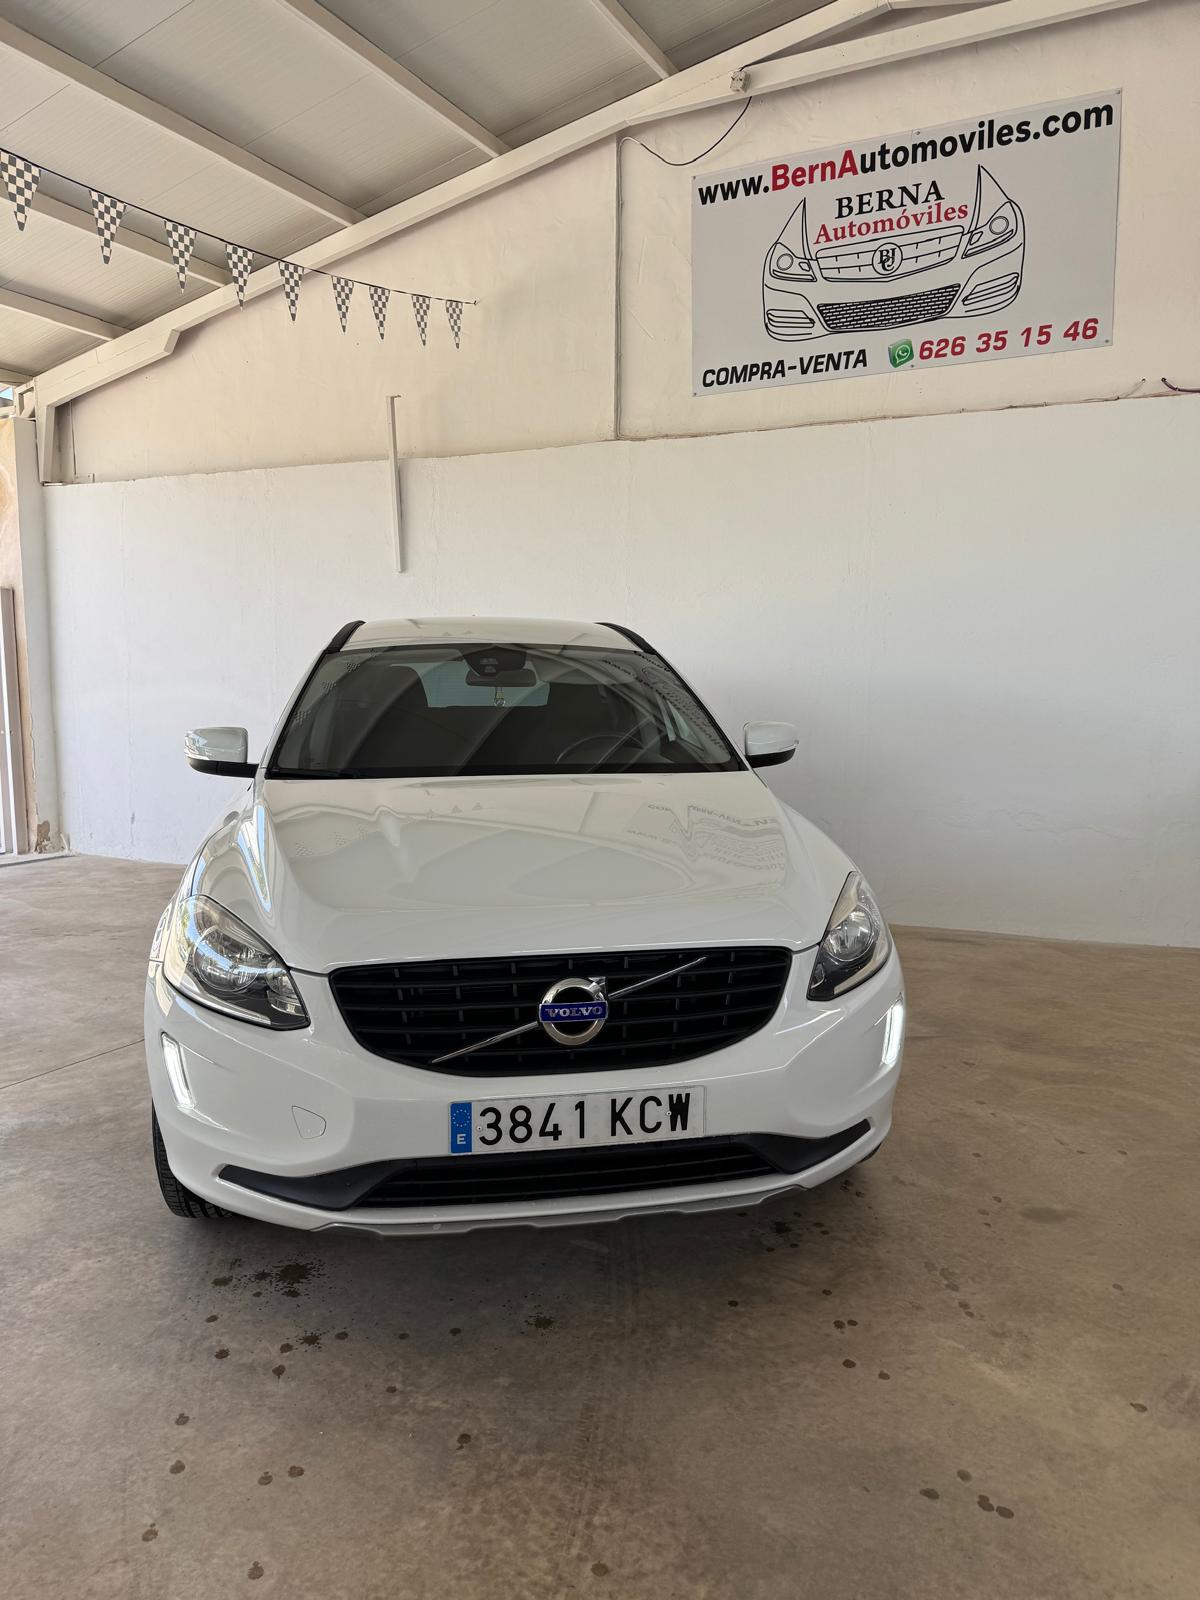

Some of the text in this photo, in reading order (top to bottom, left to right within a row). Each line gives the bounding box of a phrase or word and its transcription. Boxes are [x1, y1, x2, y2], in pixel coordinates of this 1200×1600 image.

[698, 103, 1113, 205] www.BernAutomoviles.com
[835, 180, 945, 219] BERNA
[814, 201, 969, 245] Automóviles
[919, 317, 1099, 361] 626 35 15 46
[702, 349, 867, 387] COMPRA-VENTA
[546, 1005, 603, 1018] VOLVO
[456, 1133, 466, 1145] E
[478, 1092, 691, 1146] 3841 KCW
